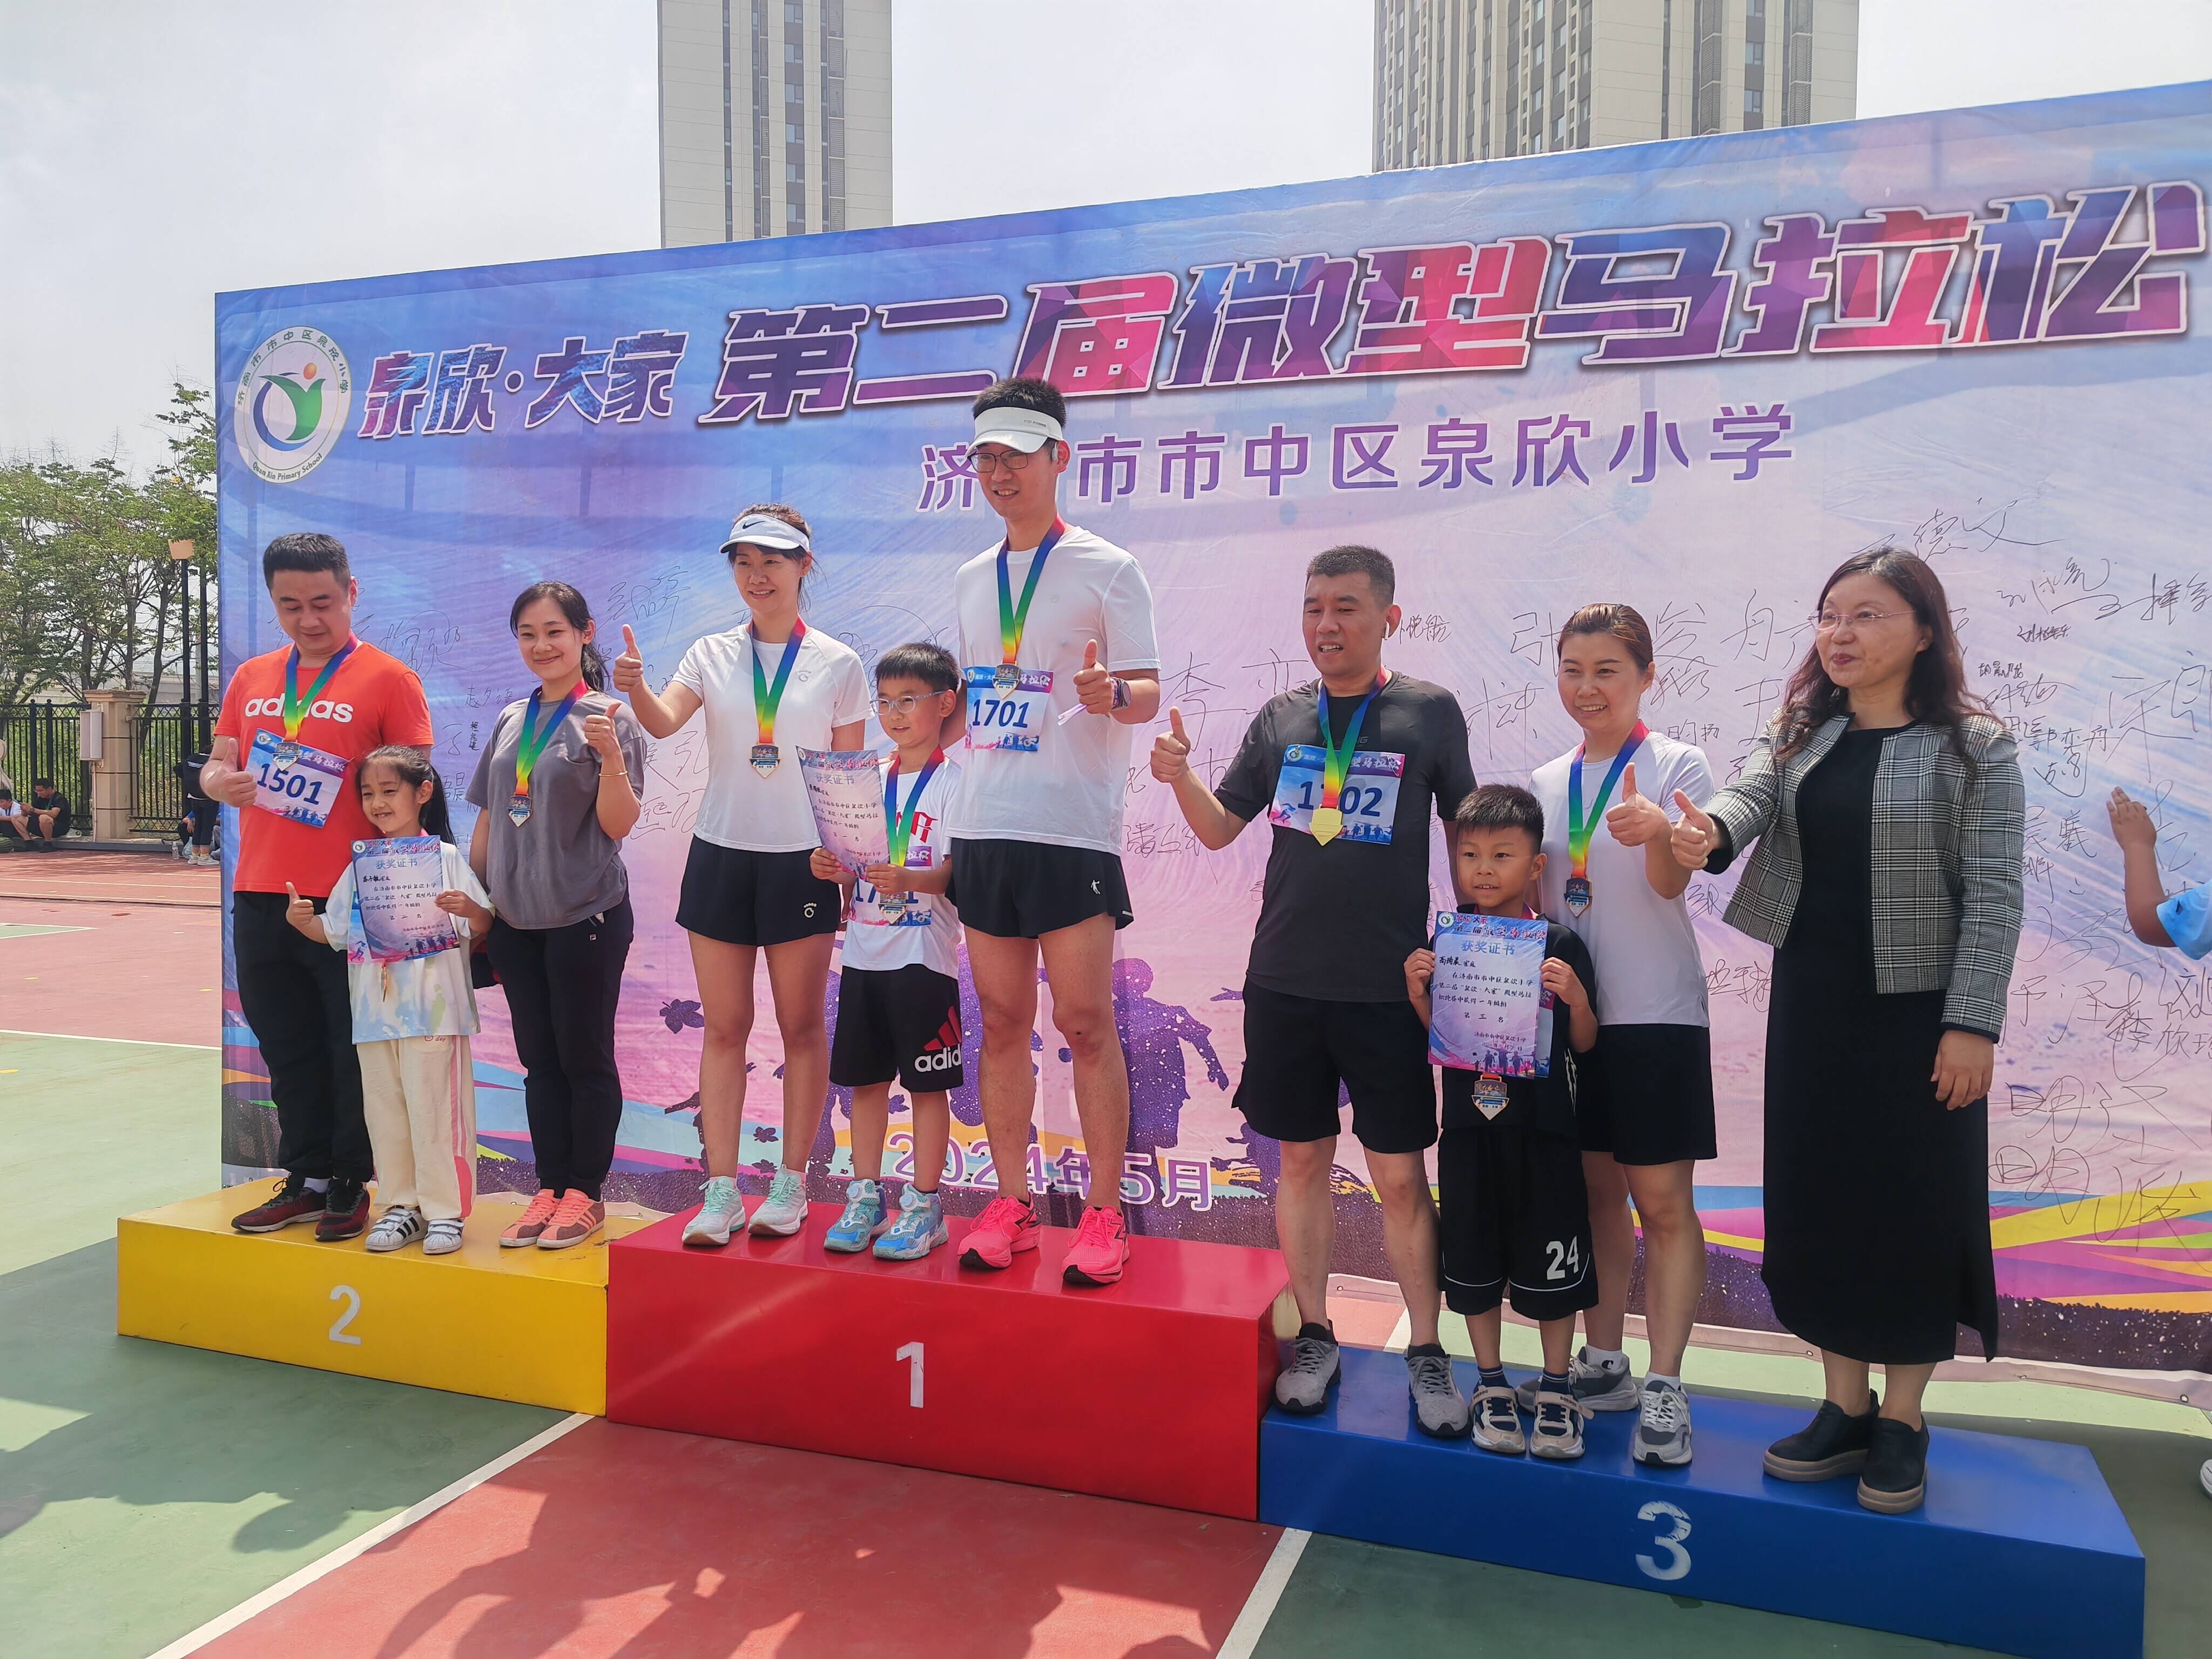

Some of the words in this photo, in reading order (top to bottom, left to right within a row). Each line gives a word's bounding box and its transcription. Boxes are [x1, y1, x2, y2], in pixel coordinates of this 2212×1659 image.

[697, 180, 2205, 425] 第二届微型马拉松
[357, 329, 689, 440] 泉欣·大家
[252, 462, 266, 476] Quan
[267, 471, 276, 480] Xin
[278, 470, 301, 480] Primary
[301, 453, 322, 473] School
[916, 402, 1796, 512] 济市市中区泉欣小学
[245, 693, 354, 723] adas
[973, 699, 1029, 728] 1701
[257, 763, 323, 805] 1501
[815, 773, 854, 785] 获奖证书
[1298, 781, 1382, 817] 102
[375, 857, 418, 869] 获奖证书
[1460, 940, 1515, 956] 获奖证书
[1546, 1235, 1579, 1280] 24
[329, 1284, 361, 1345] 2
[896, 1341, 924, 1408] 1
[1635, 1500, 1692, 1580] 3
